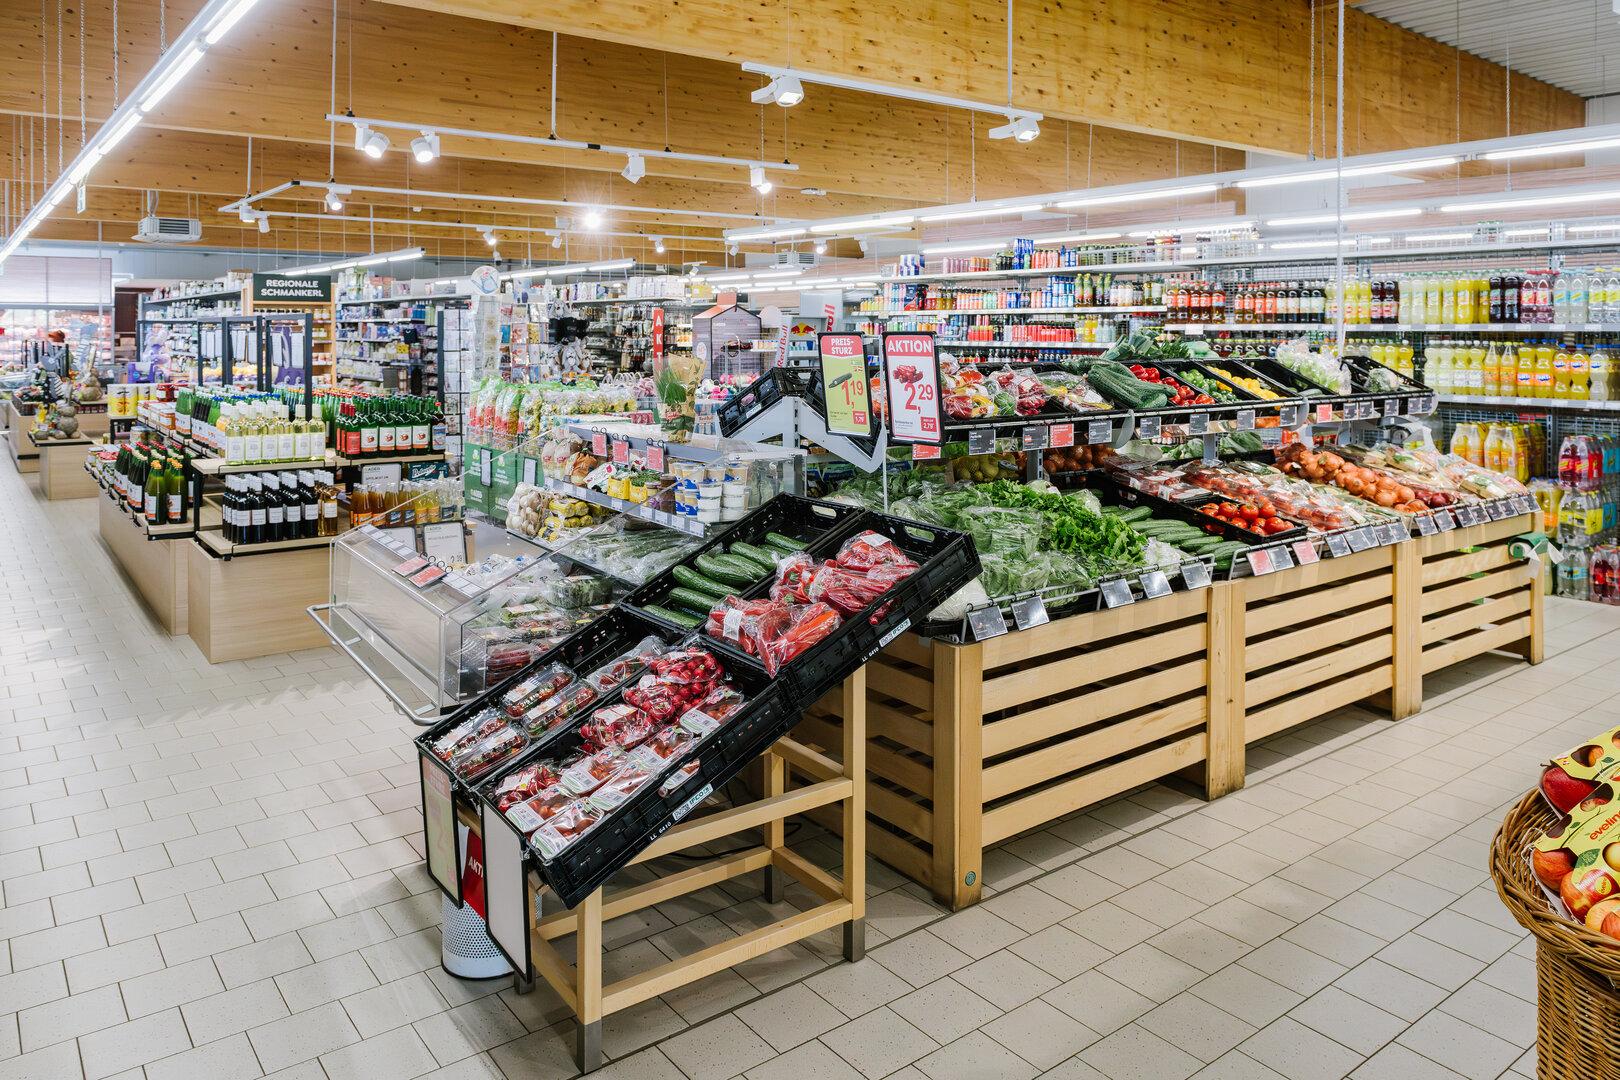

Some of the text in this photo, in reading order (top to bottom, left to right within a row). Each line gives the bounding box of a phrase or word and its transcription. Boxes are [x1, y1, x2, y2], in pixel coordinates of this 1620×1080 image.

[266, 279, 319, 288] REGIONALE
[260, 288, 324, 297] SCHMANKERL
[831, 337, 855, 347] PREIS-
[887, 339, 932, 353] AKTION
[831, 346, 853, 356] STURZ
